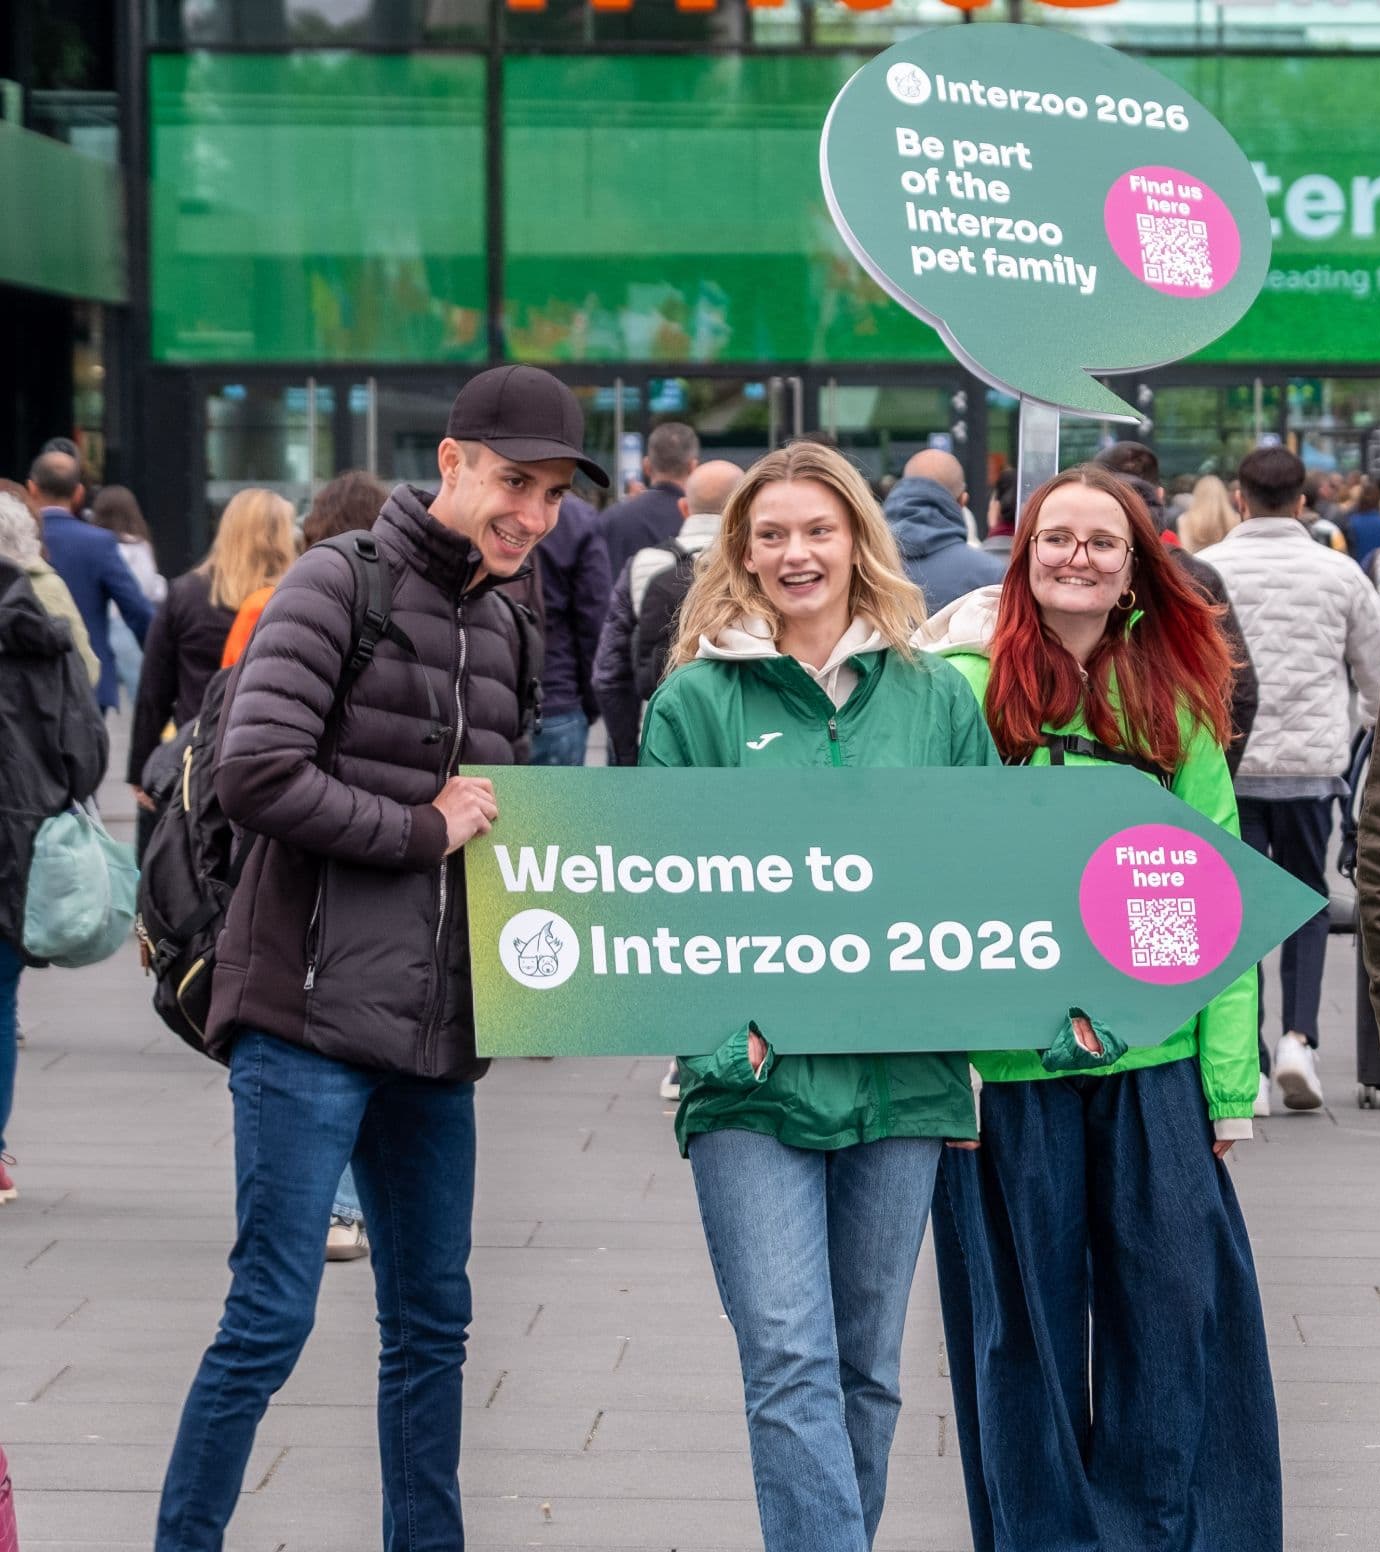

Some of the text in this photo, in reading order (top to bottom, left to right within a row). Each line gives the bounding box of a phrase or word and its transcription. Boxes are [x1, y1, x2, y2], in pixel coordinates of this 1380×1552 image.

[935, 74, 1190, 132] Interzoo 2026
[895, 127, 1033, 170] Be part
[900, 167, 1012, 203] of the
[1128, 175, 1204, 201] Find us
[905, 201, 1064, 247] Interzoo
[1146, 194, 1191, 217] here
[910, 245, 1097, 295] pet family
[1267, 264, 1371, 298] eading
[493, 844, 875, 894] Welcome to
[1115, 845, 1199, 866] Find us
[1132, 868, 1186, 888] here
[590, 920, 1062, 975] Interzoo 2026
